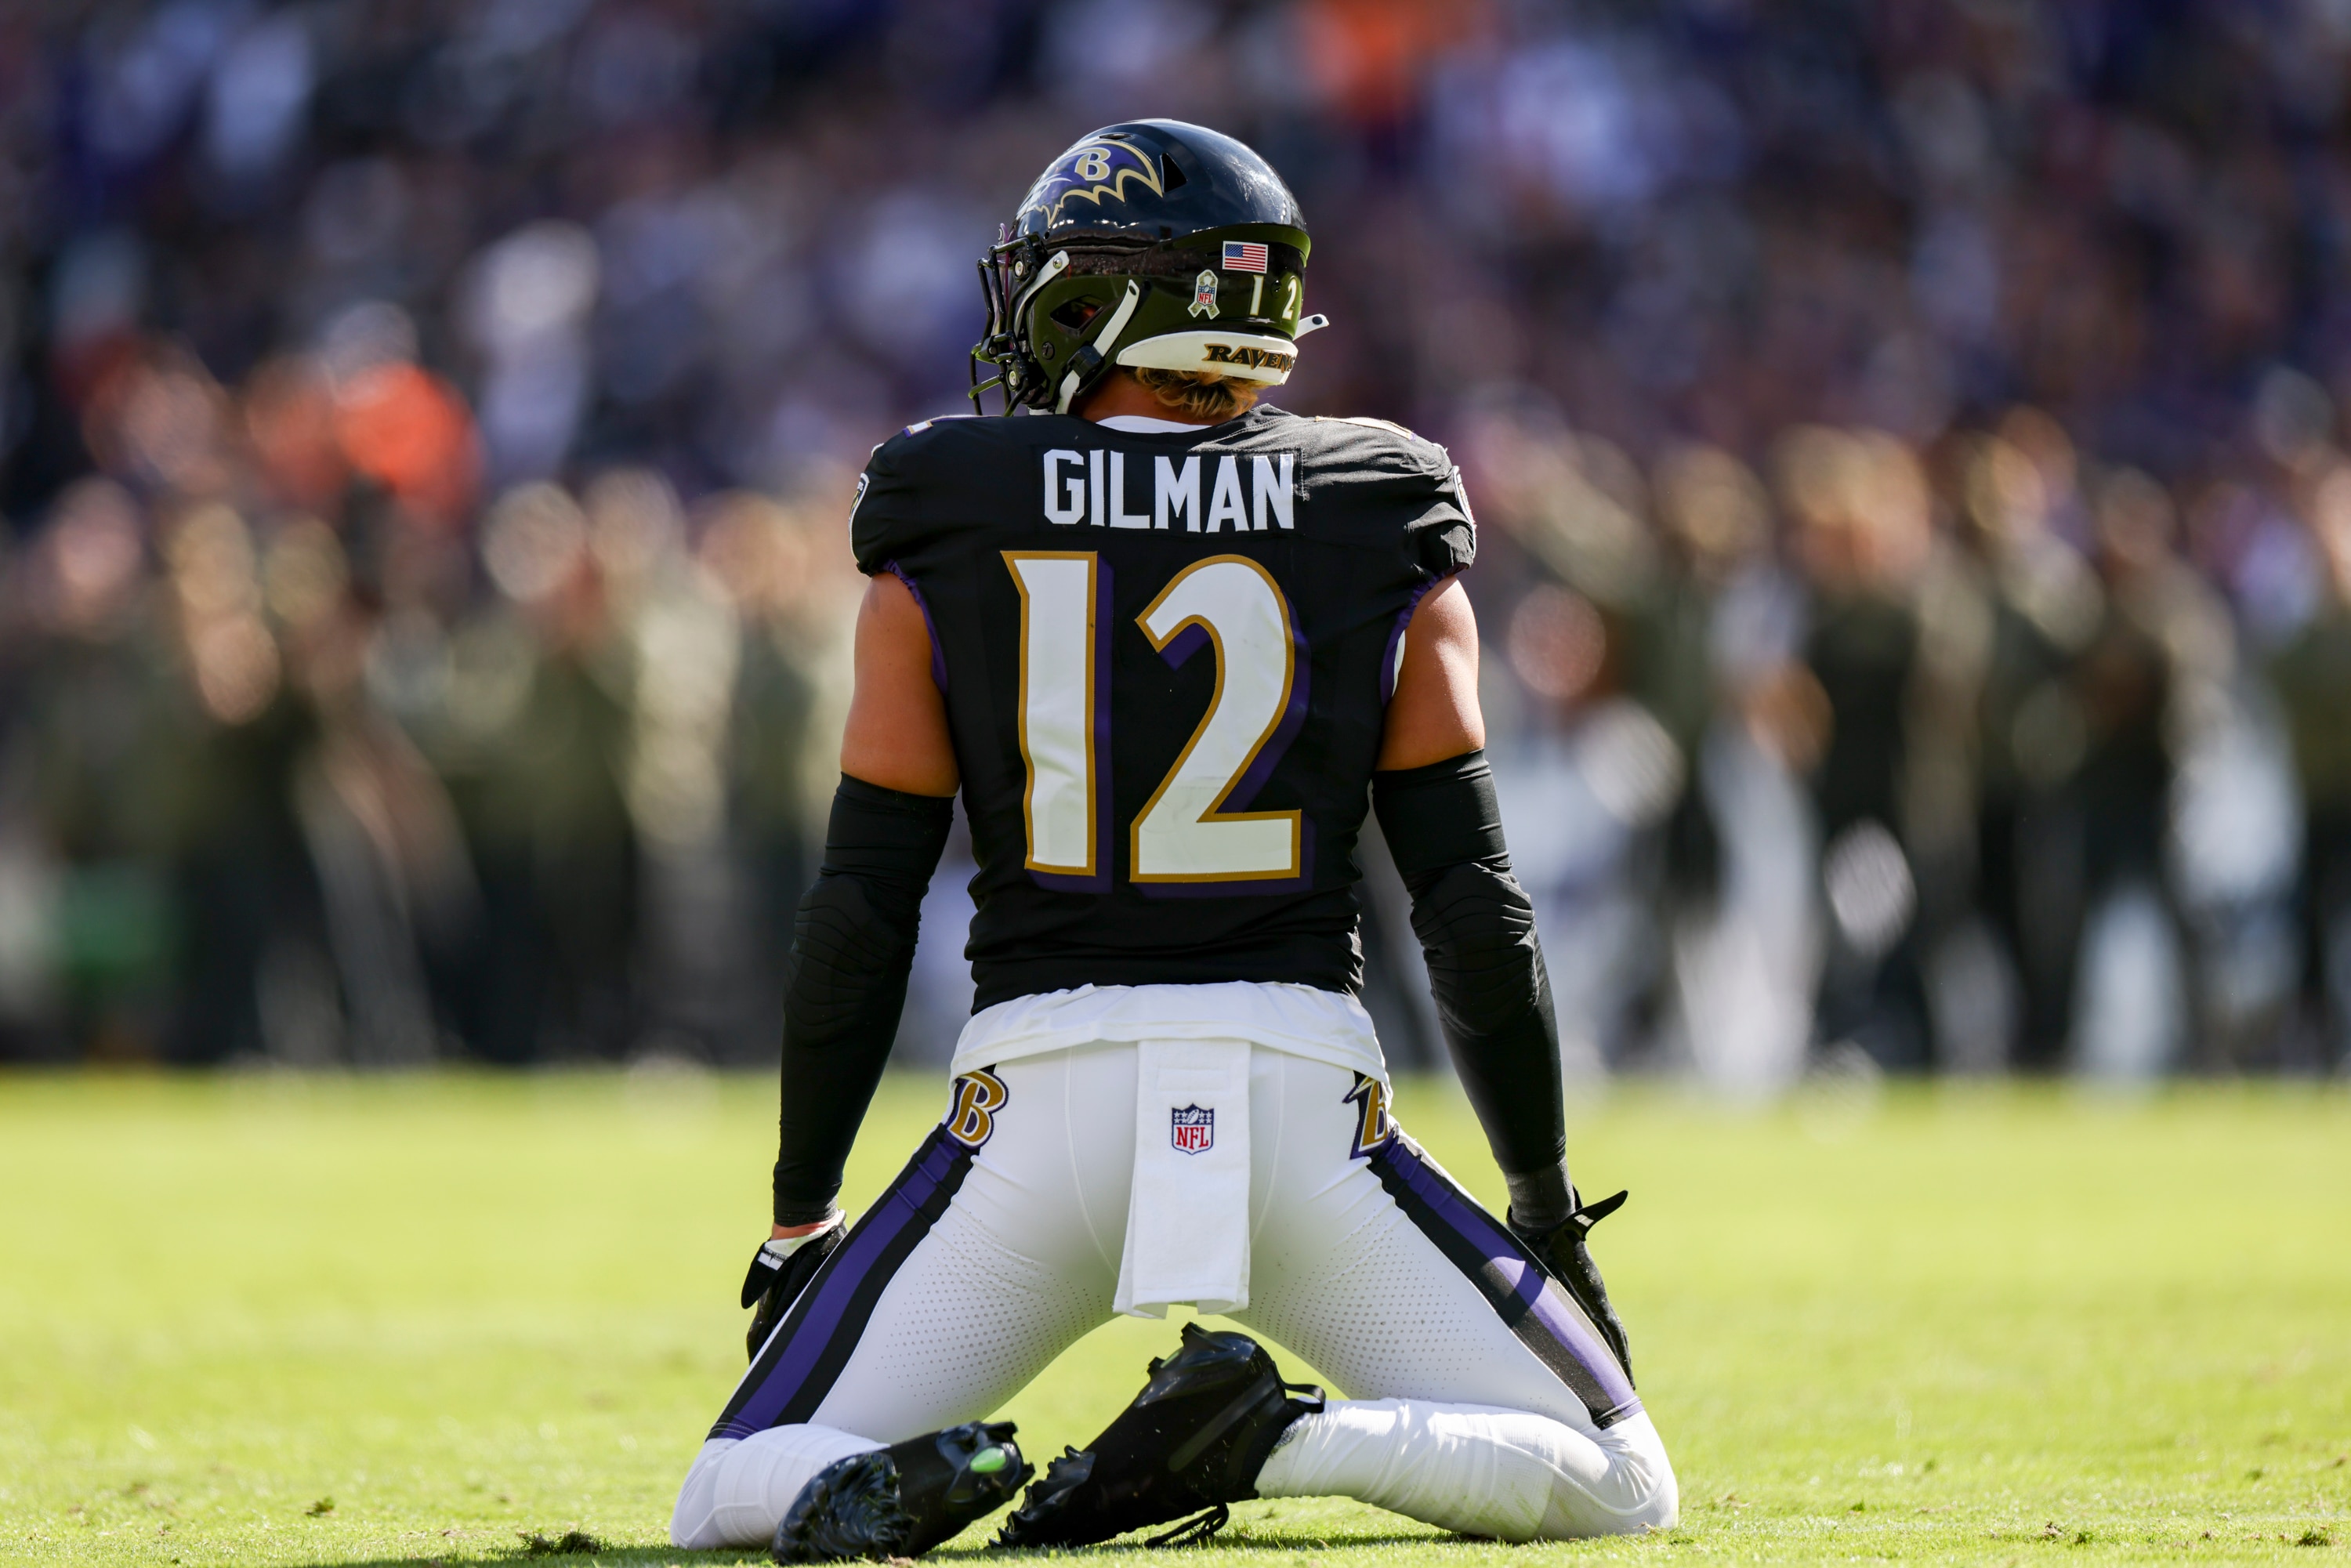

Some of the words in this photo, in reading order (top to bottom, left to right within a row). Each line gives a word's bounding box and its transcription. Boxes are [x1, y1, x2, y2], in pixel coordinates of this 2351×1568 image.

[1074, 147, 1111, 181] B
[1198, 292, 1213, 304] NFL
[1043, 448, 1295, 534] GILMAN
[1000, 550, 1304, 887] 12
[946, 1070, 1007, 1147] B
[1176, 1126, 1209, 1150] NFL
